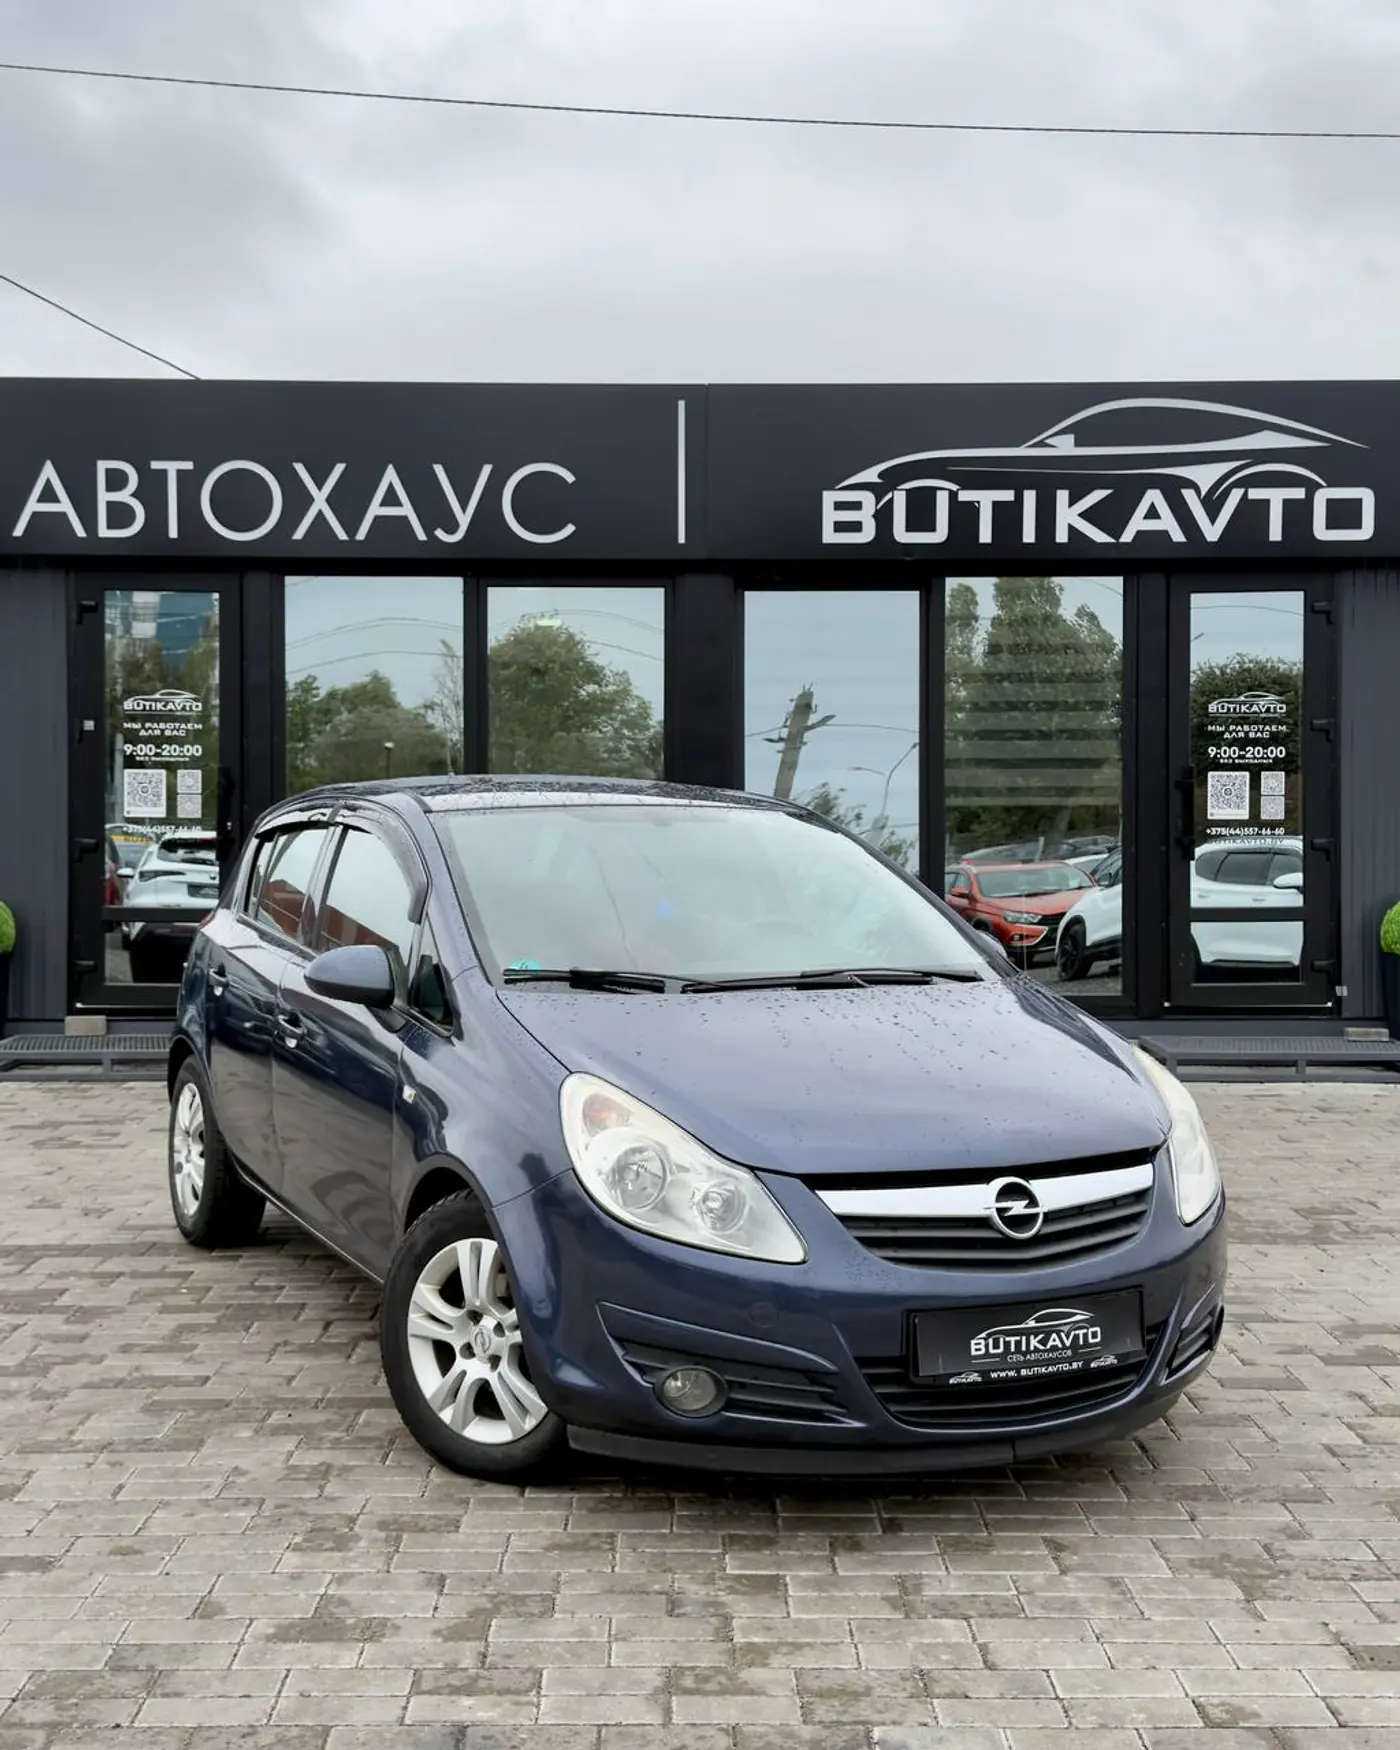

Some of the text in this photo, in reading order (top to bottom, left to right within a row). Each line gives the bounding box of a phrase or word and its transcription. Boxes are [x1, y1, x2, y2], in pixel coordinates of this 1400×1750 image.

[11, 459, 577, 544] АВТОХАУС
[821, 486, 1376, 544] BUTIKAVTO
[123, 700, 202, 711] BUTIKAVTO
[1208, 703, 1287, 713] BUTIKAVTO
[145, 722, 202, 730] РАБОТАЕМ
[1229, 724, 1287, 732] РАБОТАЕМ
[1224, 731, 1245, 739] ДЛЯ
[123, 743, 202, 756] 9:00-20:00
[1207, 746, 1286, 758] 9:00-20:00
[1206, 827, 1285, 836] +375(44)557-66-60
[970, 1327, 1101, 1355] BUTIKAVTO
[1020, 1361, 1084, 1376] BUTIKAVTO.BY
